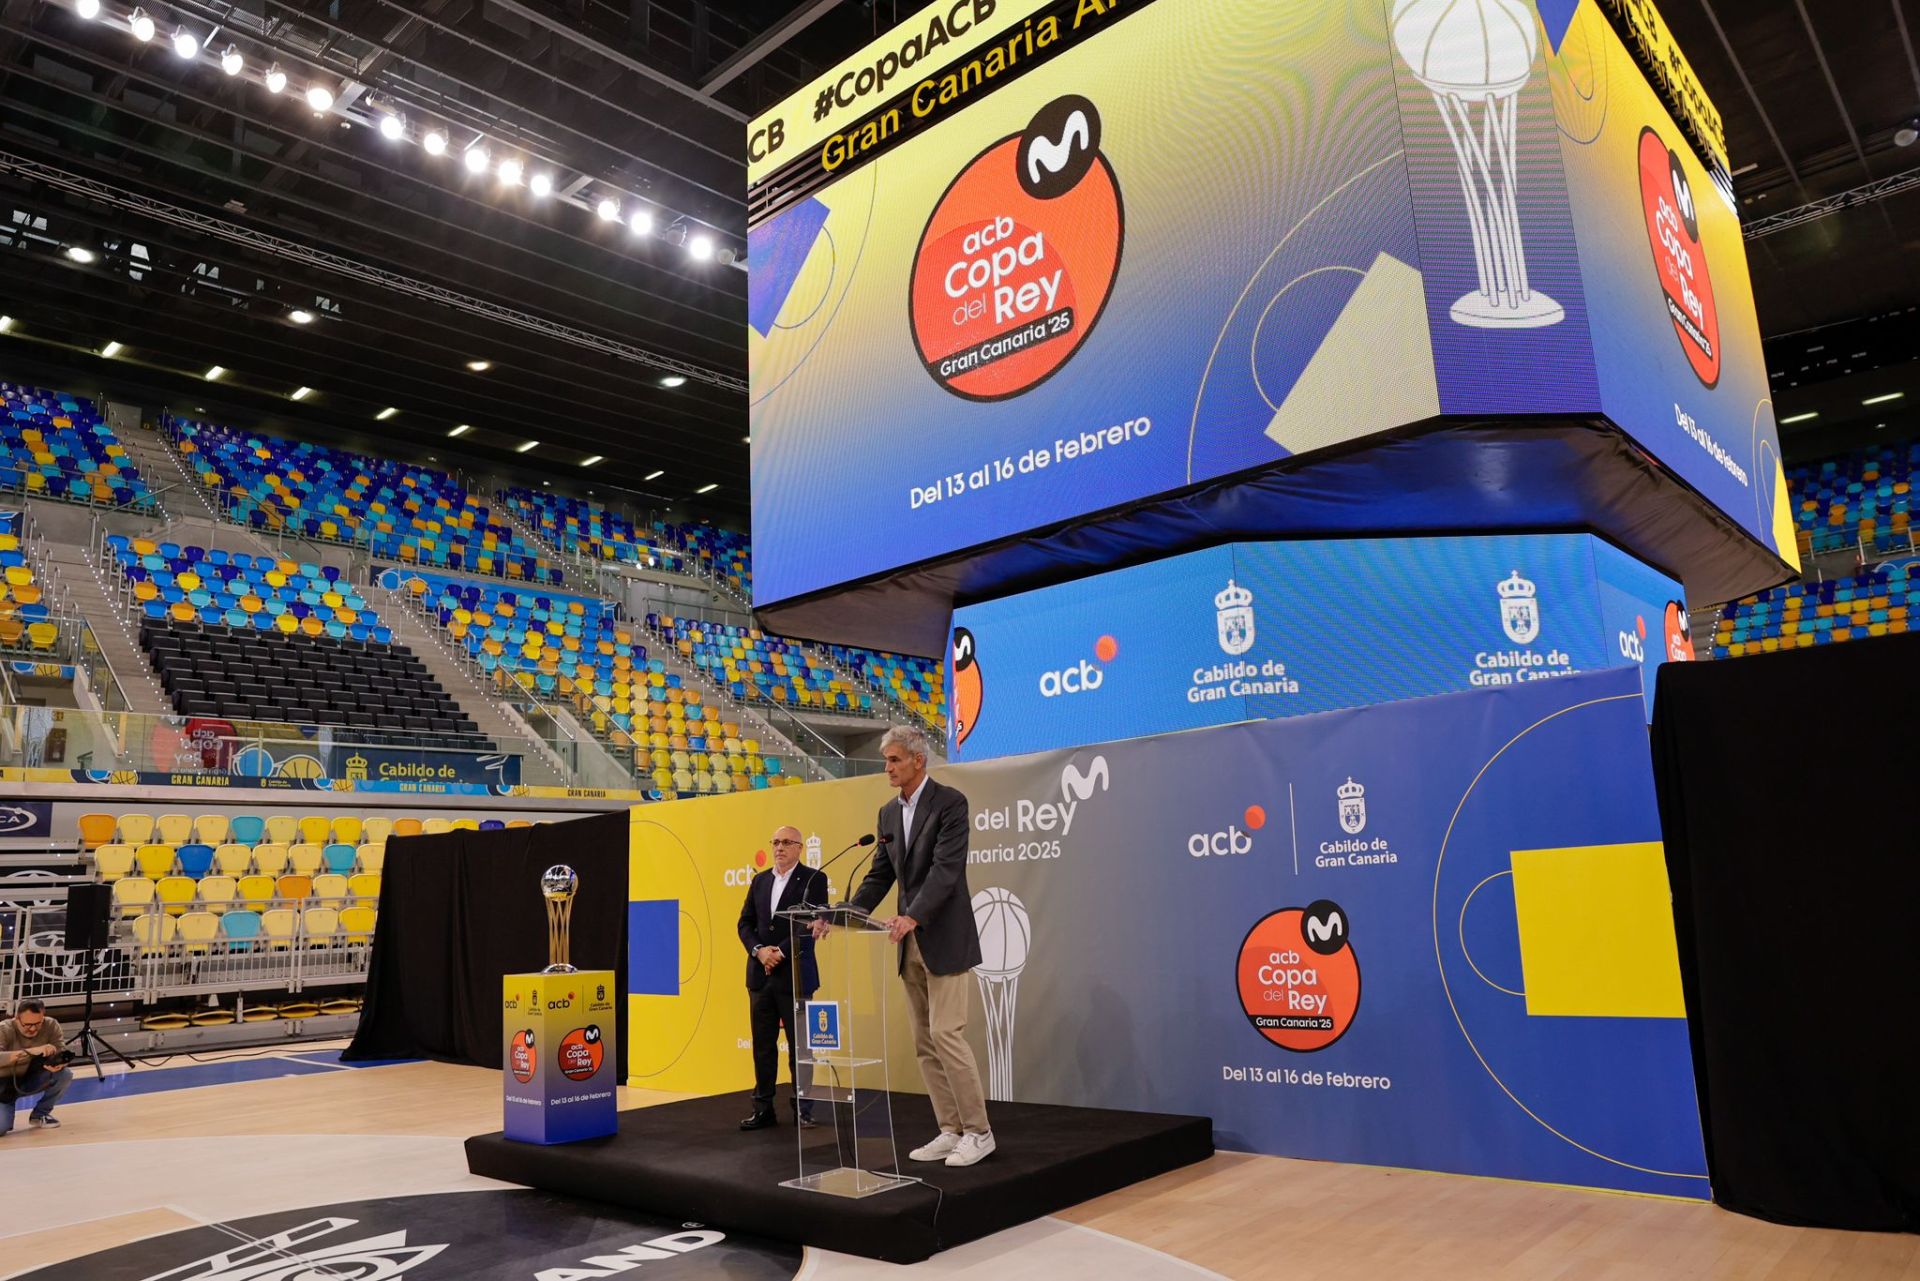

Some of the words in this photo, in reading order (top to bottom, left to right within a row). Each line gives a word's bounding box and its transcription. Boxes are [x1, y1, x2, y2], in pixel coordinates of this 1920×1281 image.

[813, 0, 996, 123] #CopaACB
[821, 108, 899, 171] Gran
[912, 15, 1060, 118] Canaria
[963, 216, 1014, 255] acb
[1656, 210, 1694, 280] Copa
[945, 232, 1044, 298] Copa
[953, 292, 987, 325] del
[994, 269, 1063, 324] Rey
[1680, 272, 1704, 330] Rey
[940, 352, 978, 376] Gran
[980, 323, 1046, 360] Canaria
[1048, 312, 1070, 333] '25
[910, 480, 942, 509] Del
[945, 472, 965, 497] 13
[969, 464, 990, 489] al
[994, 456, 1014, 481] 16
[1018, 449, 1051, 473] de
[1055, 416, 1151, 463] Febrero
[1475, 650, 1543, 668] Cabildo
[1547, 649, 1570, 666] de
[1619, 630, 1644, 663] acb
[1039, 659, 1103, 698] acb
[1193, 661, 1258, 685] Cabildo
[1262, 660, 1285, 676] de
[1469, 669, 1512, 685] Gran
[1187, 686, 1226, 703] Gran
[1229, 677, 1299, 697] Canaria
[171, 775, 193, 785] GRAN
[196, 776, 230, 786] CANARIA
[379, 762, 435, 777] Cabildo
[438, 764, 456, 778] de
[567, 789, 582, 797] GRAN
[584, 789, 606, 798] CANARIA
[975, 807, 1009, 831] del
[1017, 800, 1077, 836] Rey
[967, 844, 1014, 864] naria
[1018, 841, 1061, 860] 2025
[1188, 825, 1252, 857] acb
[1320, 839, 1368, 854] Cabildo
[1371, 837, 1387, 850] de
[1315, 856, 1345, 868] Gran
[1348, 851, 1397, 866] Canaria
[1269, 950, 1300, 964] acb
[1258, 965, 1317, 989] Copa
[548, 998, 570, 1009] acb
[1263, 989, 1284, 1001] del
[1288, 990, 1327, 1014] Rey
[1256, 1017, 1278, 1027] Gran
[1280, 1018, 1318, 1028] Canaria
[1319, 1019, 1332, 1028] '25
[567, 1050, 589, 1060] Copa
[577, 1058, 592, 1067] Rey
[1223, 1066, 1246, 1080] Del
[1250, 1067, 1263, 1082] 13
[1266, 1069, 1281, 1083] al
[1284, 1069, 1298, 1084] 16
[1301, 1070, 1323, 1086] de
[1327, 1072, 1391, 1089] Febrero
